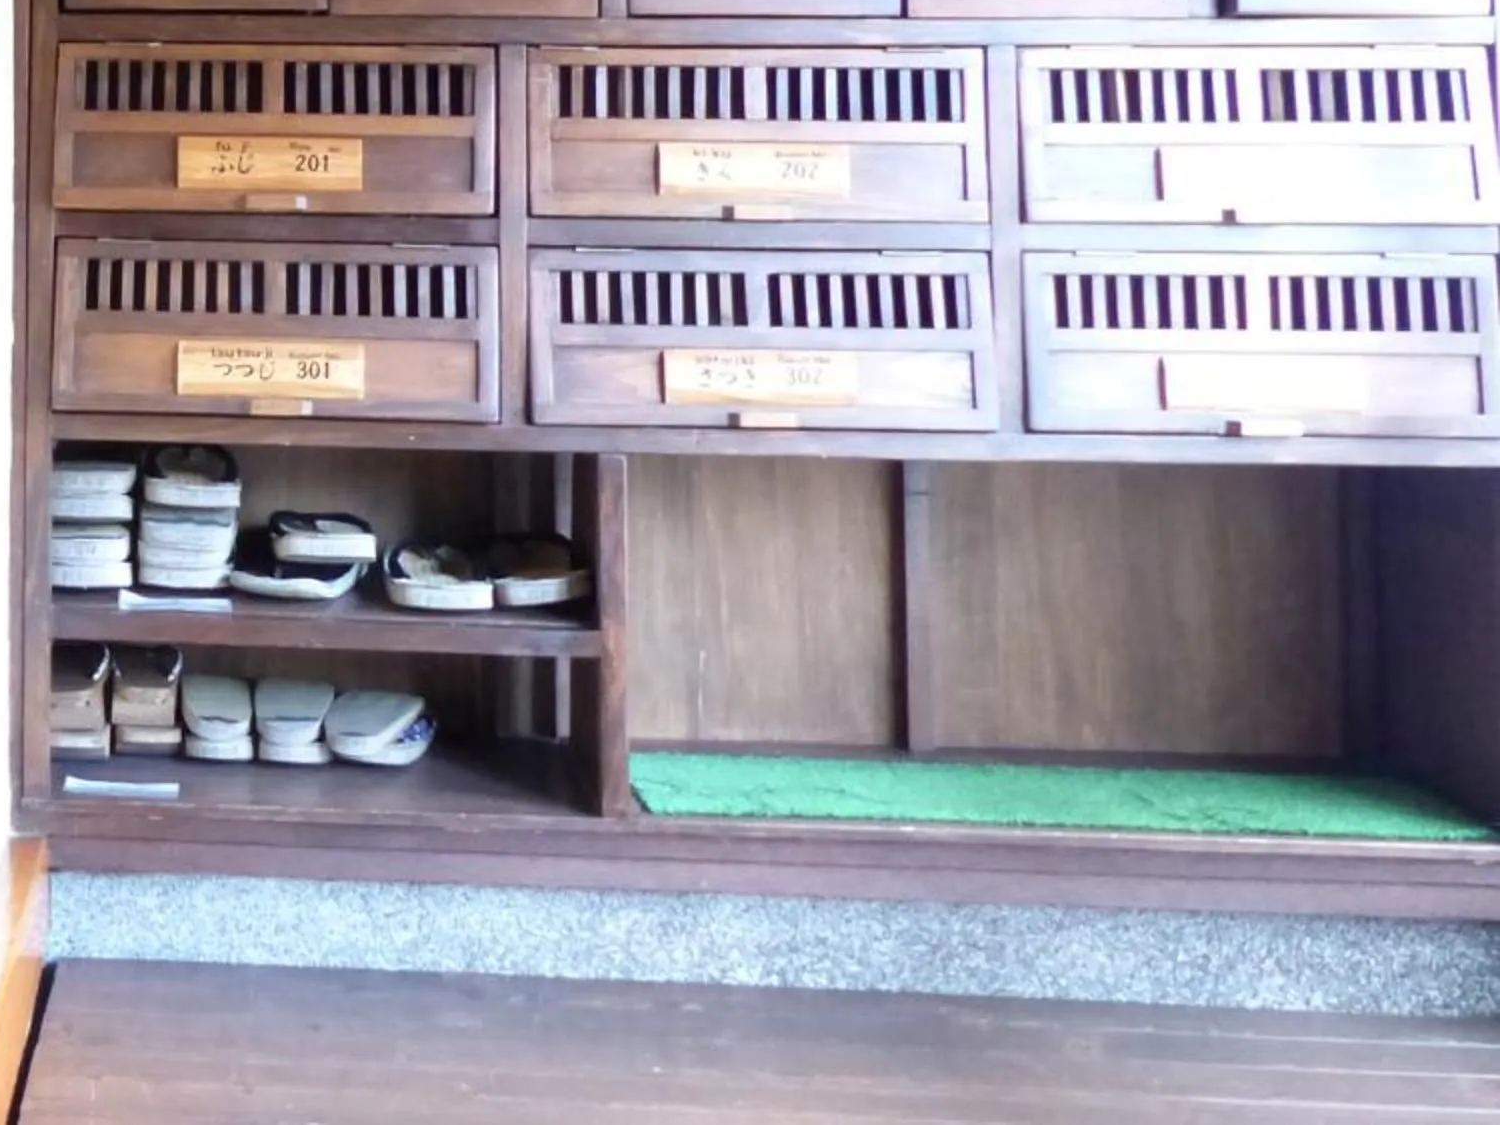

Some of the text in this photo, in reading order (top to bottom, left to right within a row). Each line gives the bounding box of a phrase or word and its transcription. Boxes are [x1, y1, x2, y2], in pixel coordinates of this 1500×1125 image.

[295, 154, 331, 173] 201
[212, 360, 276, 381] つつじ
[296, 361, 331, 380] 301
